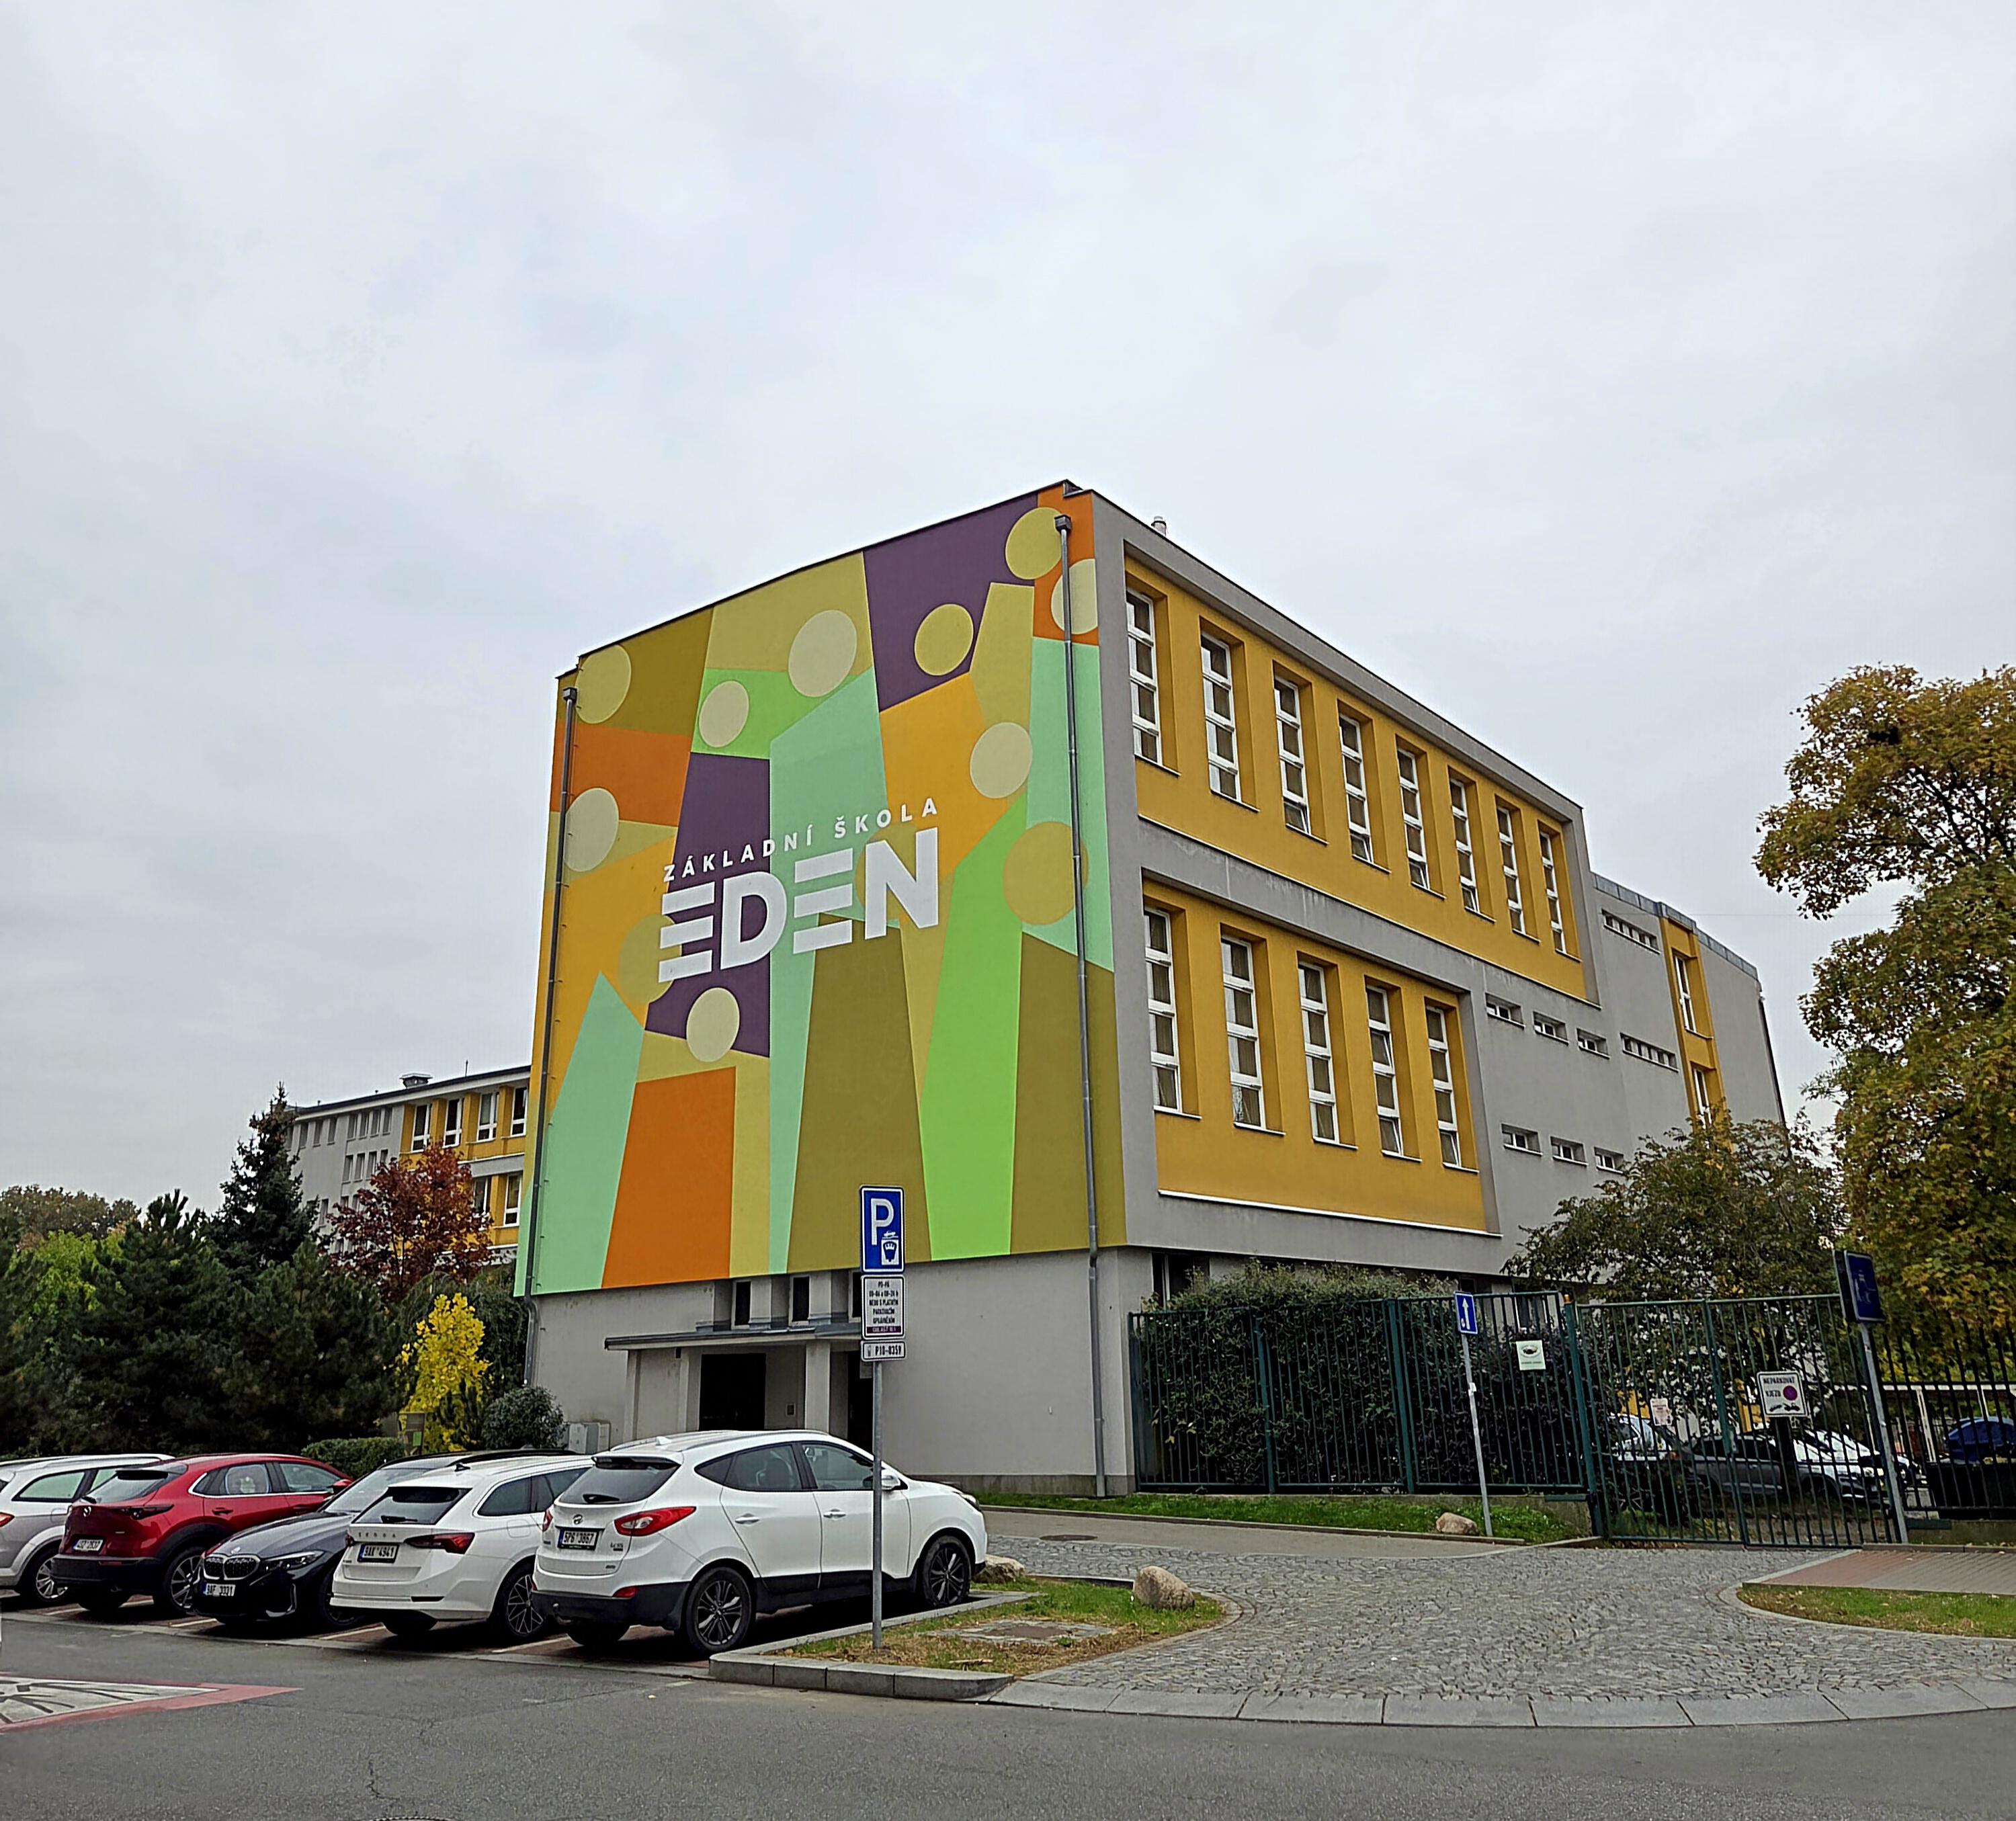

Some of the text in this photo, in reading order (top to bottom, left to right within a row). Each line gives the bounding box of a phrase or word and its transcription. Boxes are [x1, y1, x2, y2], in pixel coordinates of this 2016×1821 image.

[663, 798, 937, 882] ZÁKLADNÍ ŠKOLA
[658, 827, 939, 983] EDEN
[870, 1197, 894, 1245] P
